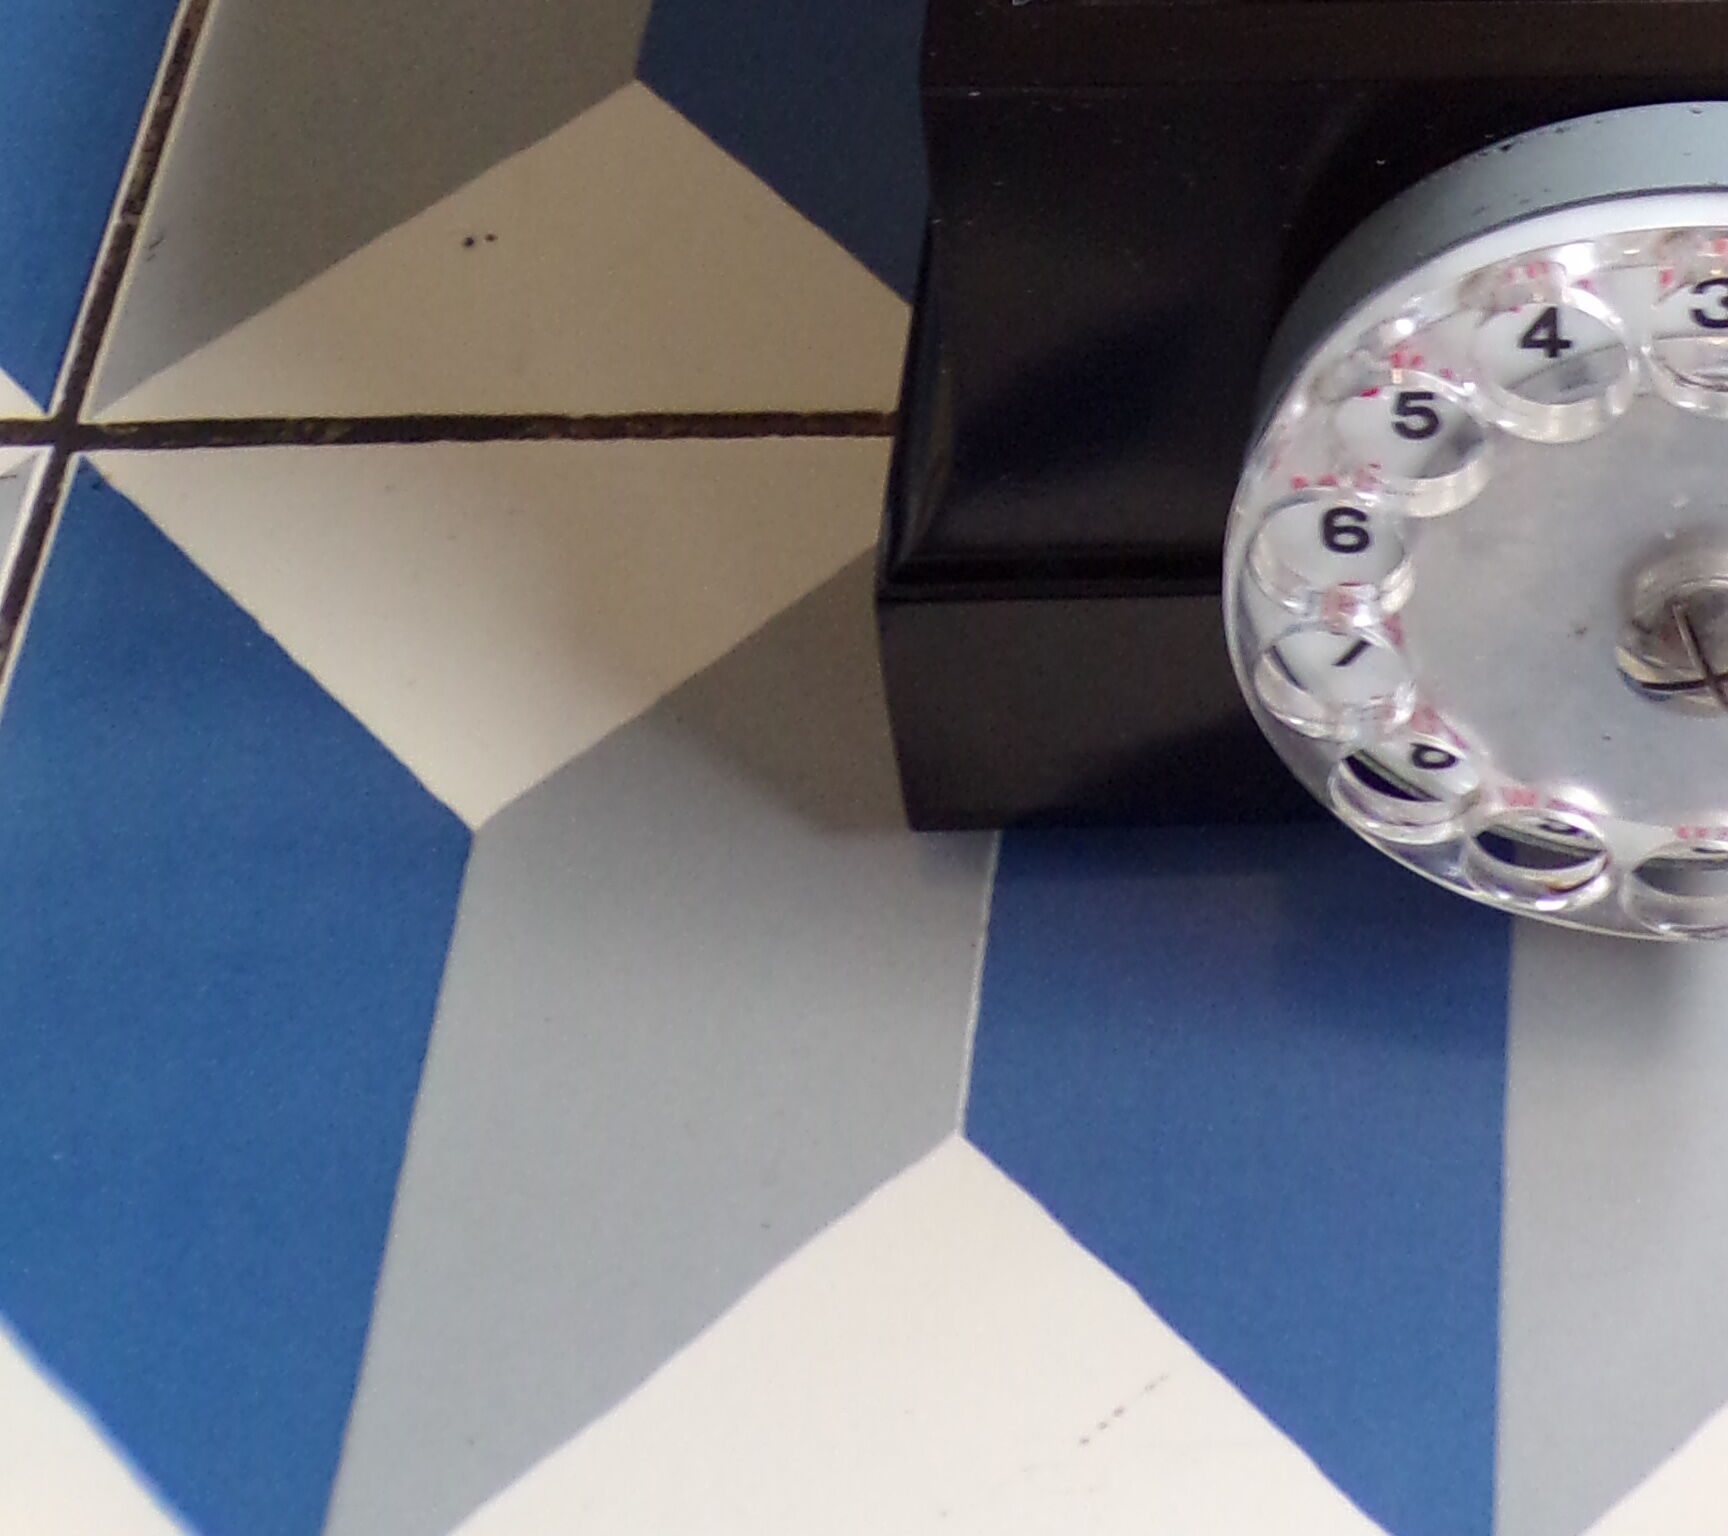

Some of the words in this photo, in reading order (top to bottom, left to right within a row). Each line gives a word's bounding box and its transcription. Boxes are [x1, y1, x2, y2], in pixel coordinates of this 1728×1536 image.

[1520, 306, 1572, 358] 4
[1391, 390, 1440, 440] 5
[1321, 506, 1371, 554] 6
